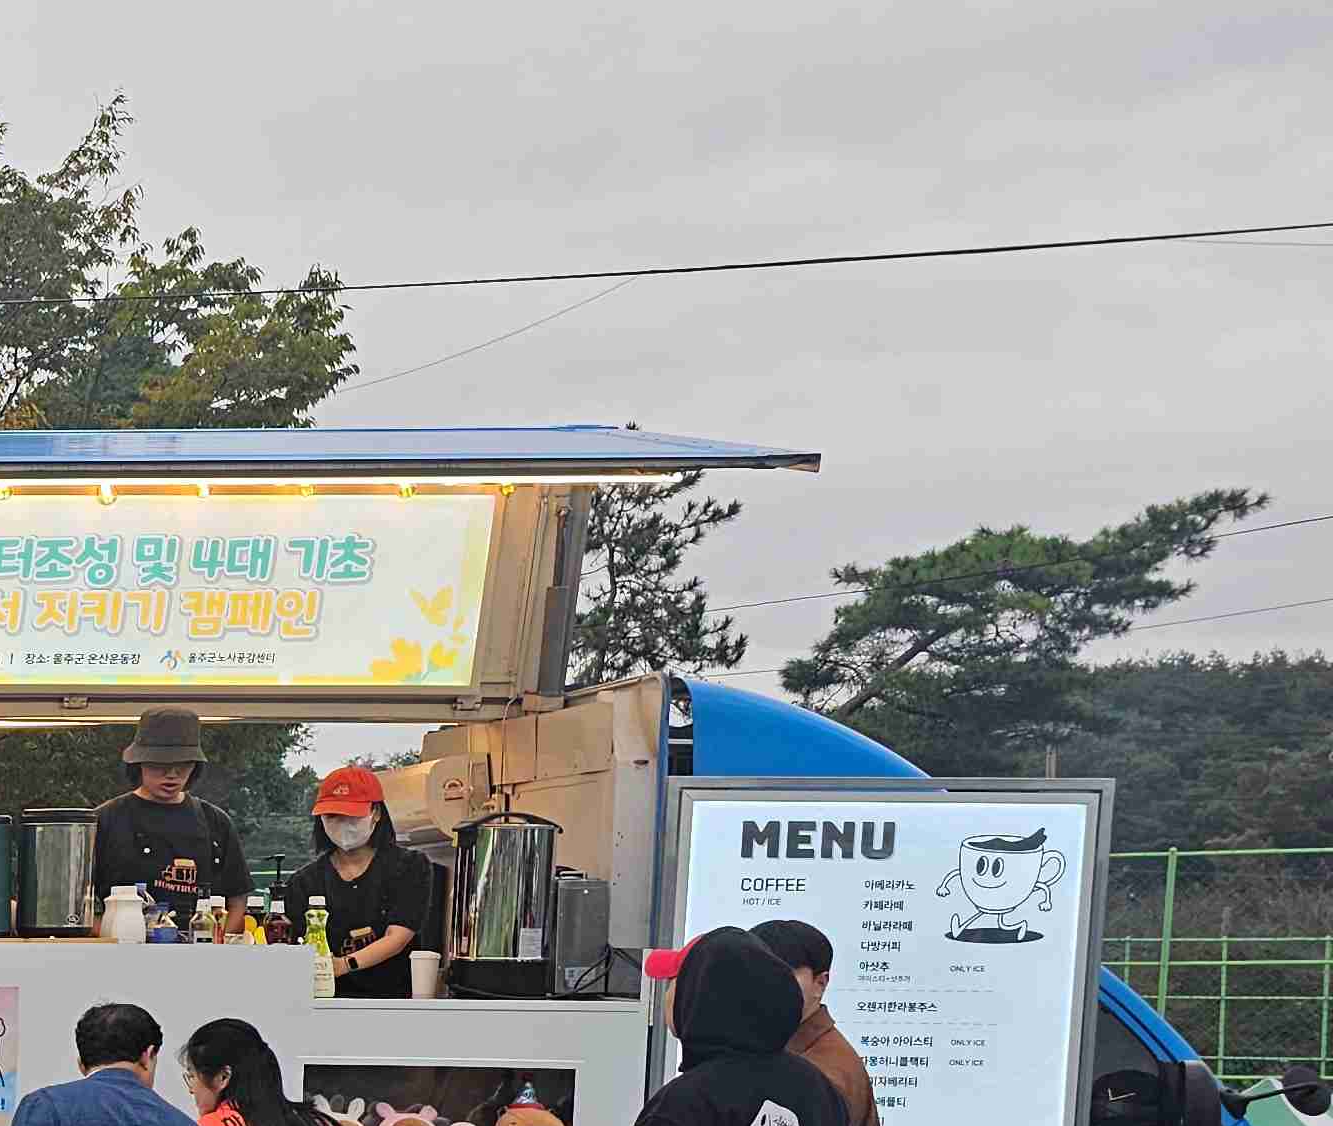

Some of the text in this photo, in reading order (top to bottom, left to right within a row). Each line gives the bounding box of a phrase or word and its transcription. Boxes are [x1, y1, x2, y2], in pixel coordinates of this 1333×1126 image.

[132, 535, 180, 584] 및
[193, 534, 272, 582] 4대
[283, 534, 376, 583] 기초
[35, 589, 169, 635] 지키기
[181, 590, 323, 640] 캠페인
[23, 652, 50, 665] 장소:
[53, 652, 85, 665] 울주군
[87, 653, 141, 665] 온산운동장
[188, 652, 277, 664] 울주군노사공감센터
[740, 819, 897, 860] MENU
[741, 878, 807, 892] COFFEE
[864, 880, 916, 891] 아메리카노
[743, 898, 782, 906] HOT ICE
[862, 899, 904, 911] 카페라떼
[861, 920, 913, 932] 바닐라라떼
[861, 941, 901, 952] 다방커피
[859, 961, 890, 972] 아샷추
[949, 965, 986, 973] ONLY ICE
[856, 1001, 938, 1013] 오렌지한라봉주스
[860, 1035, 934, 1048] 복숭아 아이스티
[950, 1039, 986, 1047] ONLY ICE
[948, 1059, 985, 1067] ONLY ICE
